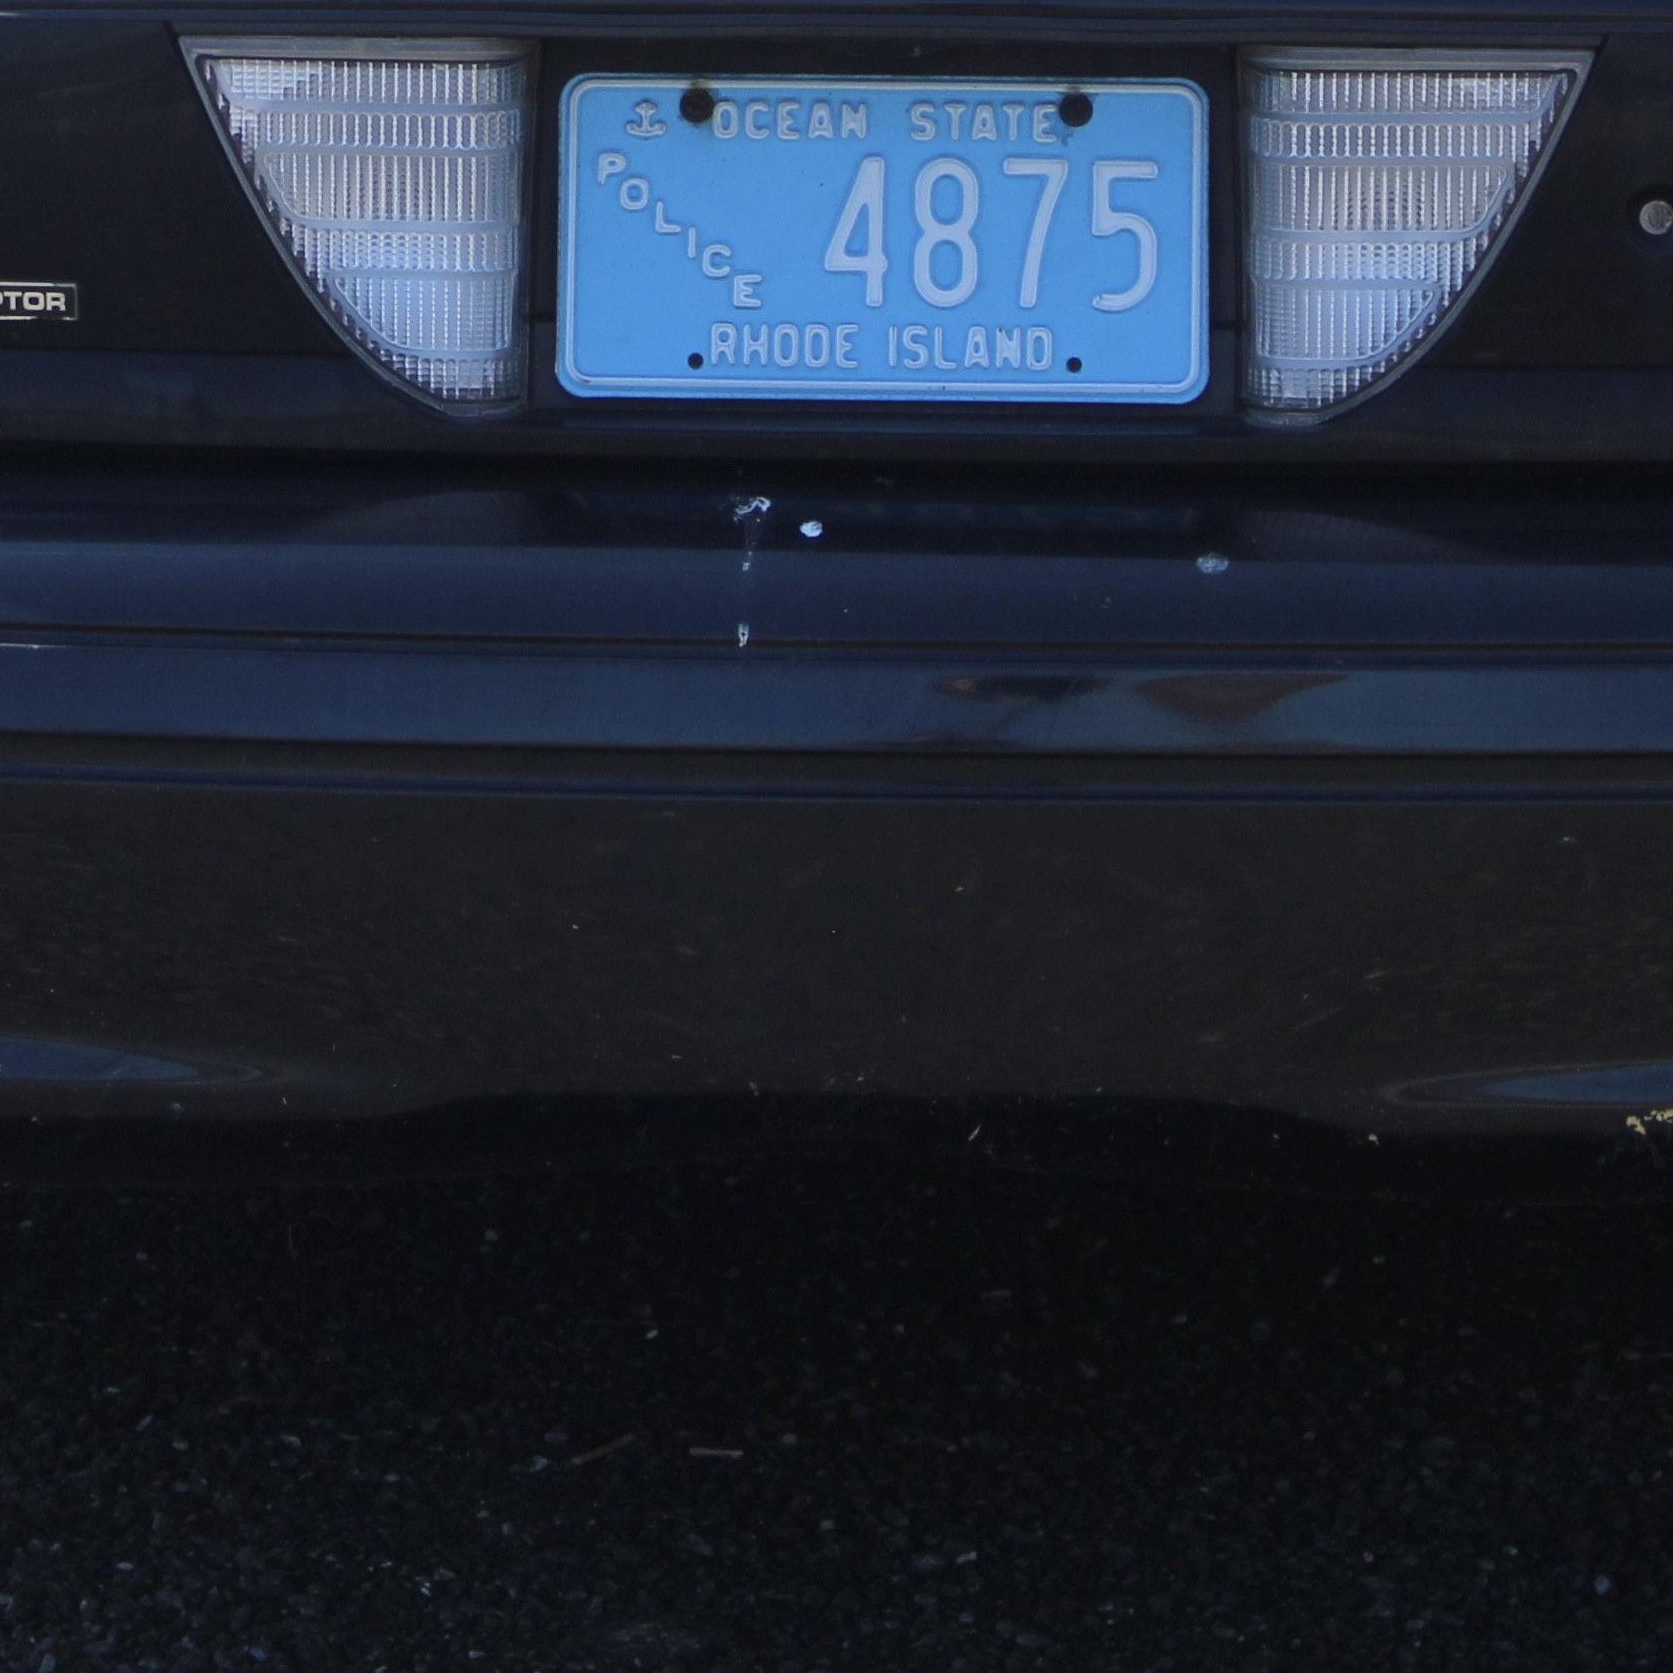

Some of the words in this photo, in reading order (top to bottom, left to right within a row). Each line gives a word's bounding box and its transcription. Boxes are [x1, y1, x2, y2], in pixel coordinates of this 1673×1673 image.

[712, 100, 868, 141] OCEAN
[909, 102, 1060, 144] STATE
[597, 152, 763, 310] POLICE
[824, 155, 1159, 312] 4875
[710, 322, 859, 370] RHODE
[888, 324, 1053, 372] ISLAND
